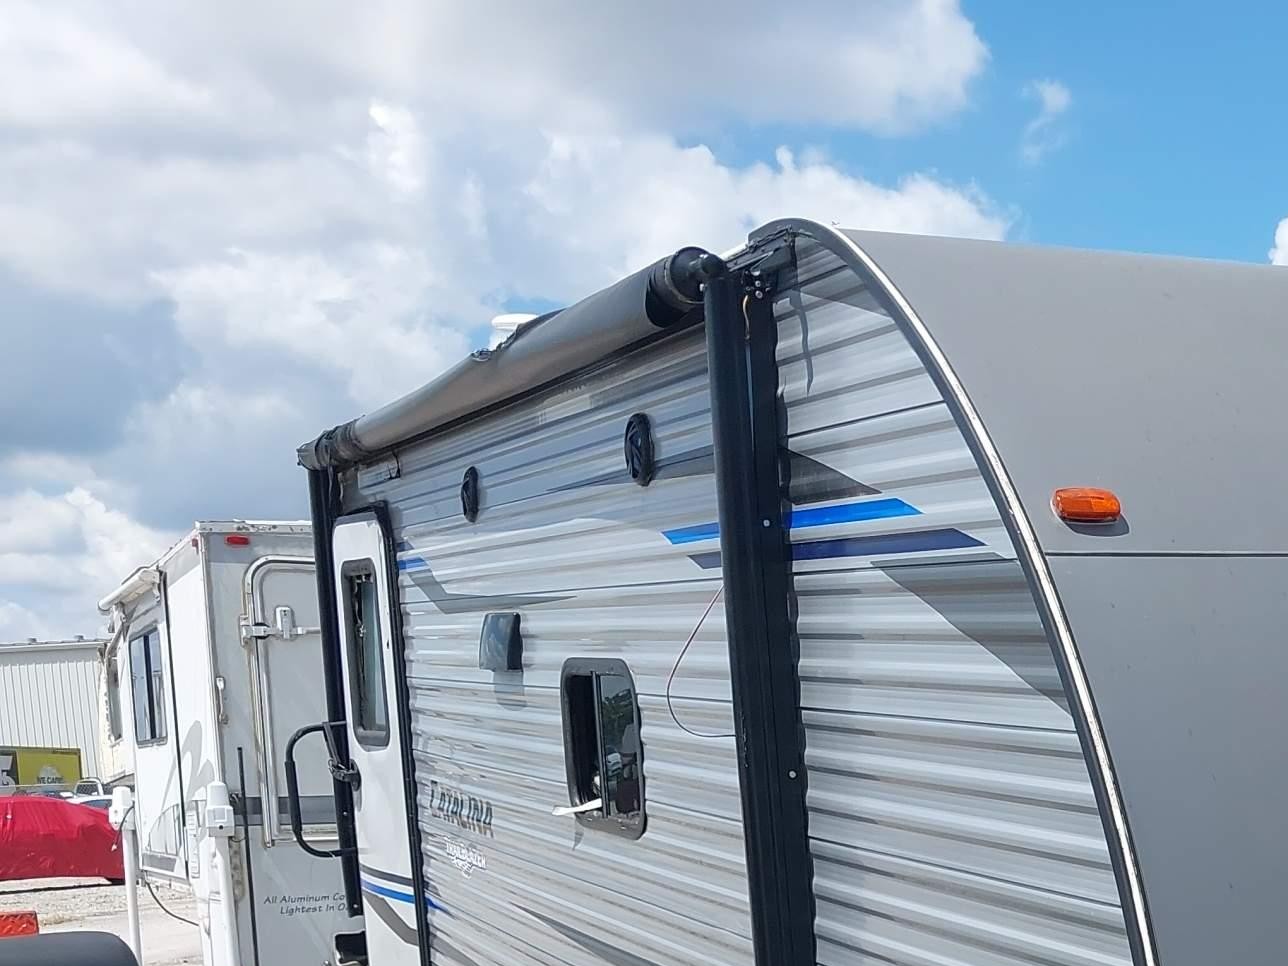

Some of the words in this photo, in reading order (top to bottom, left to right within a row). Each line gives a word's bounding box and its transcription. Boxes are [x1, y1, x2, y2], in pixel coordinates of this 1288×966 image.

[263, 895, 278, 905] All
[280, 894, 330, 904] Aluminum
[280, 905, 322, 916] Lightest
